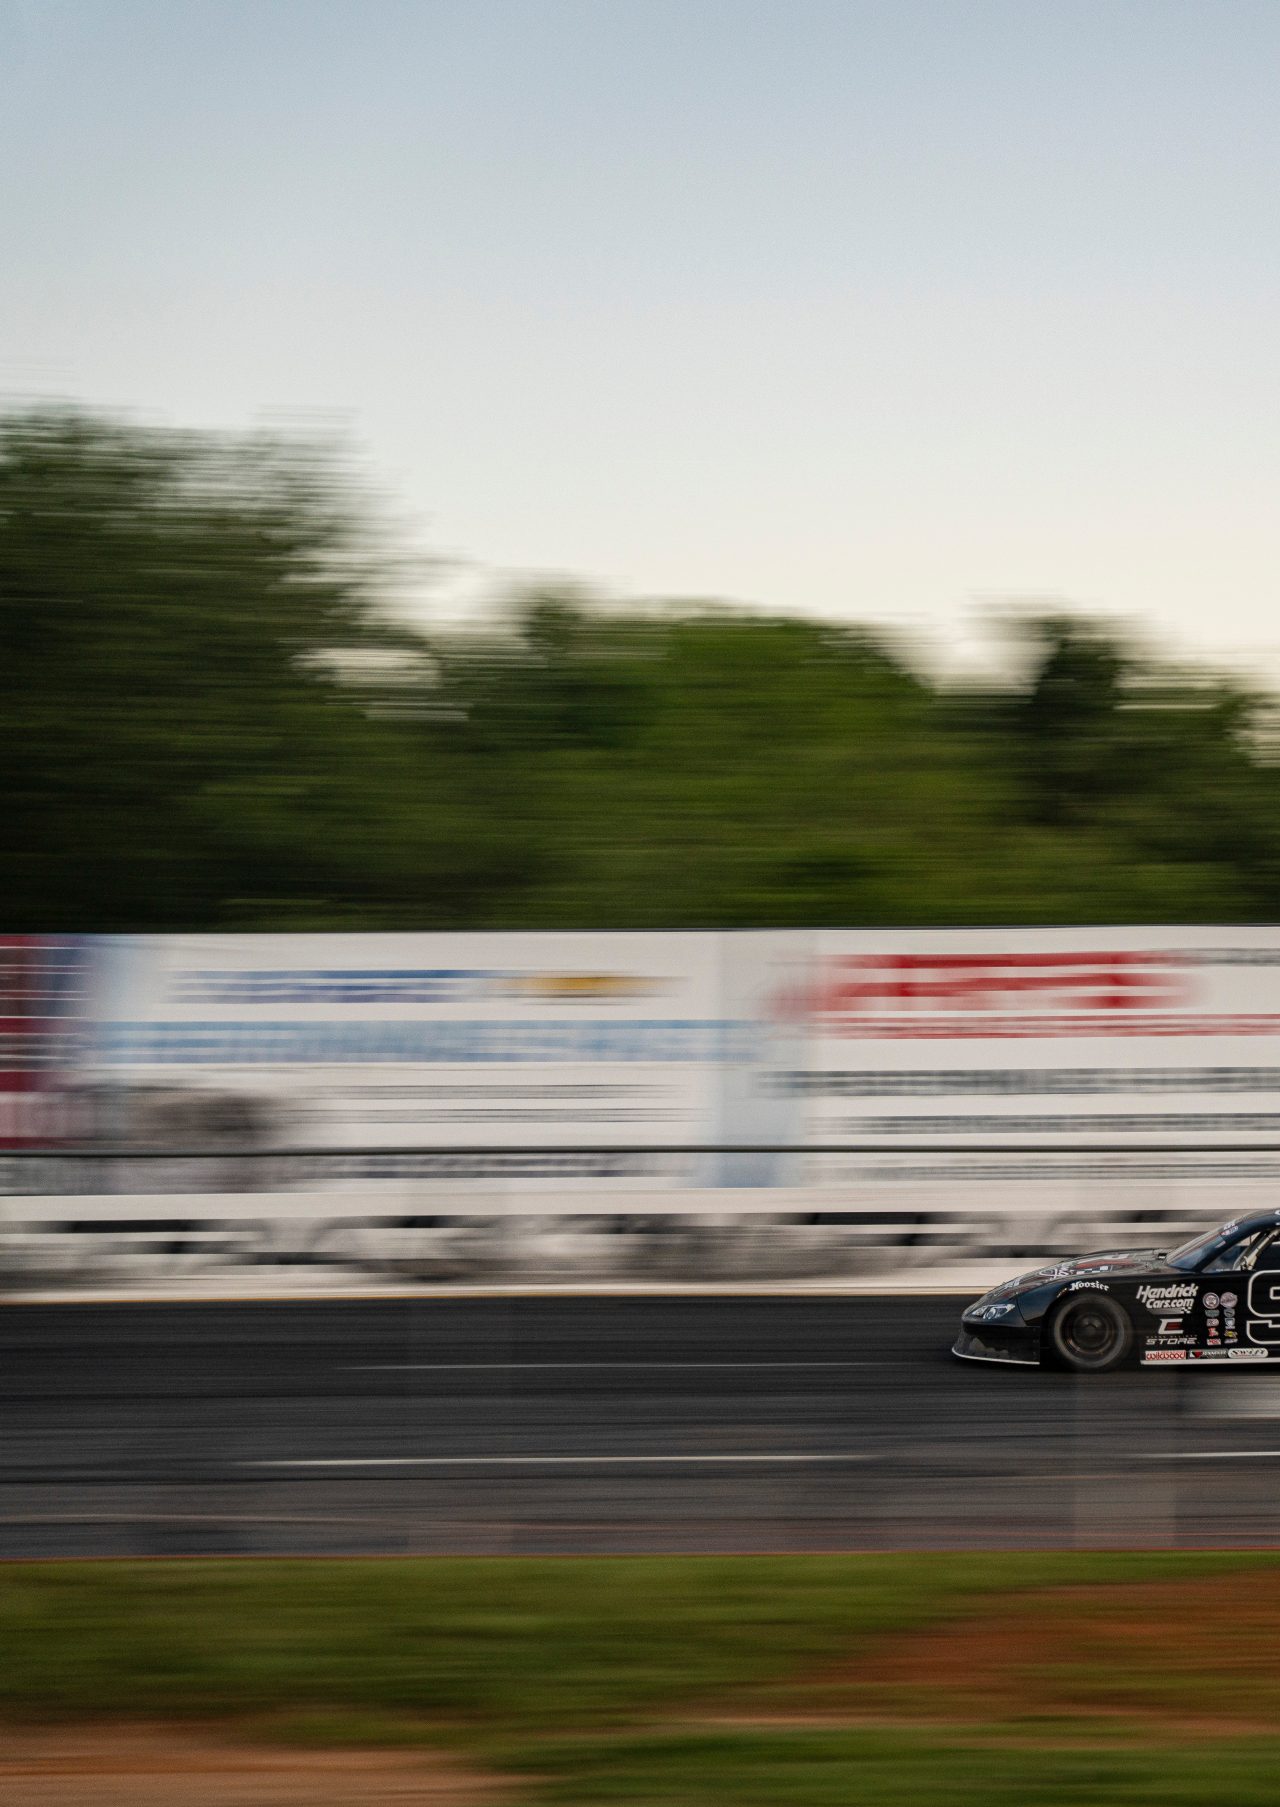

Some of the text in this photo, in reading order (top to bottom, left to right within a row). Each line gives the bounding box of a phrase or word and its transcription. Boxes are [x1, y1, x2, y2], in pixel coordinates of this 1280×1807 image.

[1069, 1280, 1110, 1291] Hoosier
[1136, 1283, 1199, 1303] Hendrick
[1146, 1298, 1195, 1309] Cars.com
[1146, 1337, 1198, 1345] STORE
[1146, 1350, 1186, 1360] wilwood
